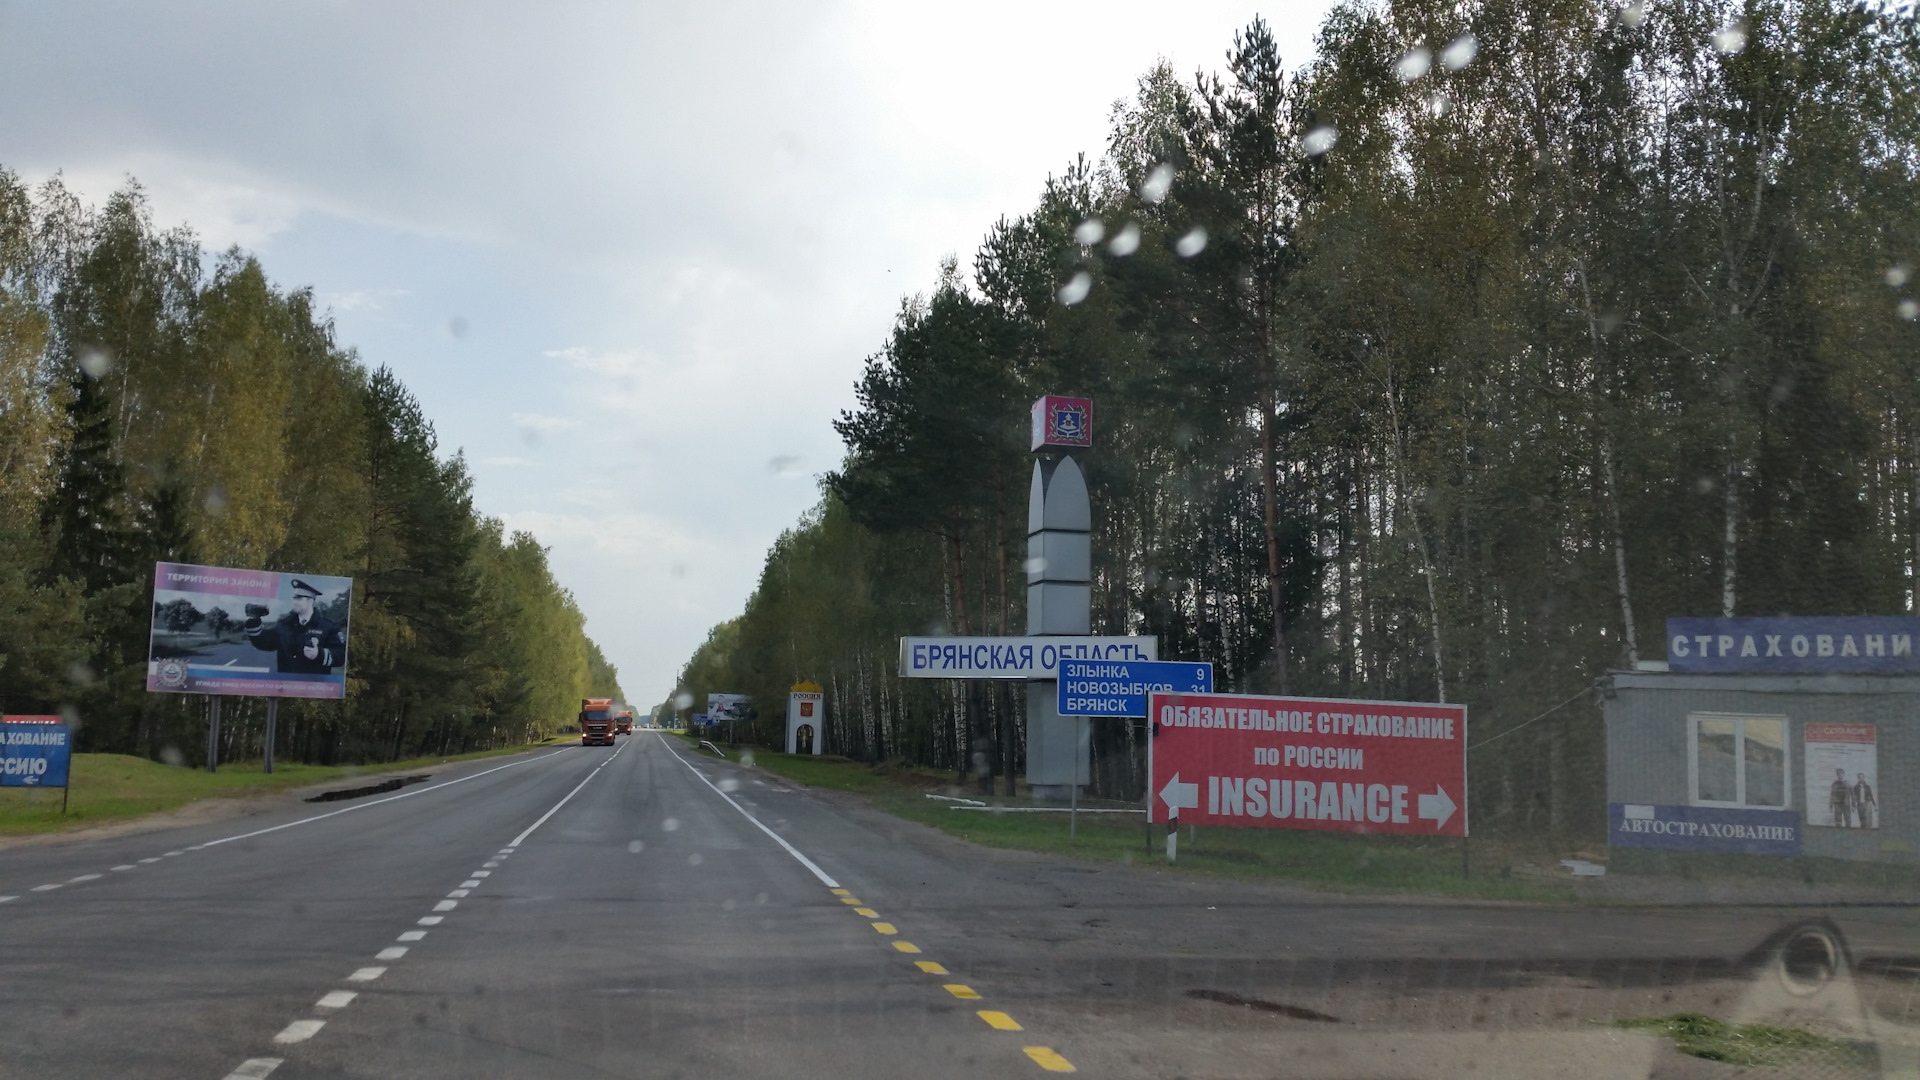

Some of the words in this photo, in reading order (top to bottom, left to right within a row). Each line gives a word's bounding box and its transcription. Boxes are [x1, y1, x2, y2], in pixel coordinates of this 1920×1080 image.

[167, 573, 229, 585] ТЕРРИТОРИЯ
[913, 644, 1033, 670] БРЯНСКАЯ
[1041, 644, 1149, 670] ОБЛАСТЬ
[1672, 634, 1912, 657] СТРАХОВАНИ
[1066, 664, 1130, 679] ЗЛЫНКА
[1196, 668, 1205, 680] 9
[1067, 681, 1173, 695] НОВОЗЫБКОВ
[1190, 684, 1206, 693] 31
[1066, 697, 1127, 712] БРЯНСК
[1161, 704, 1312, 733] ОБЯЗАТЕЛЬНОЕ
[1317, 713, 1455, 740] СТРАХОВАНИЕ
[1284, 745, 1363, 770] РОССИИ
[1208, 776, 1410, 824] INSURANCE
[1619, 818, 1795, 841] АВТОСТРАХОВАНИЕ
